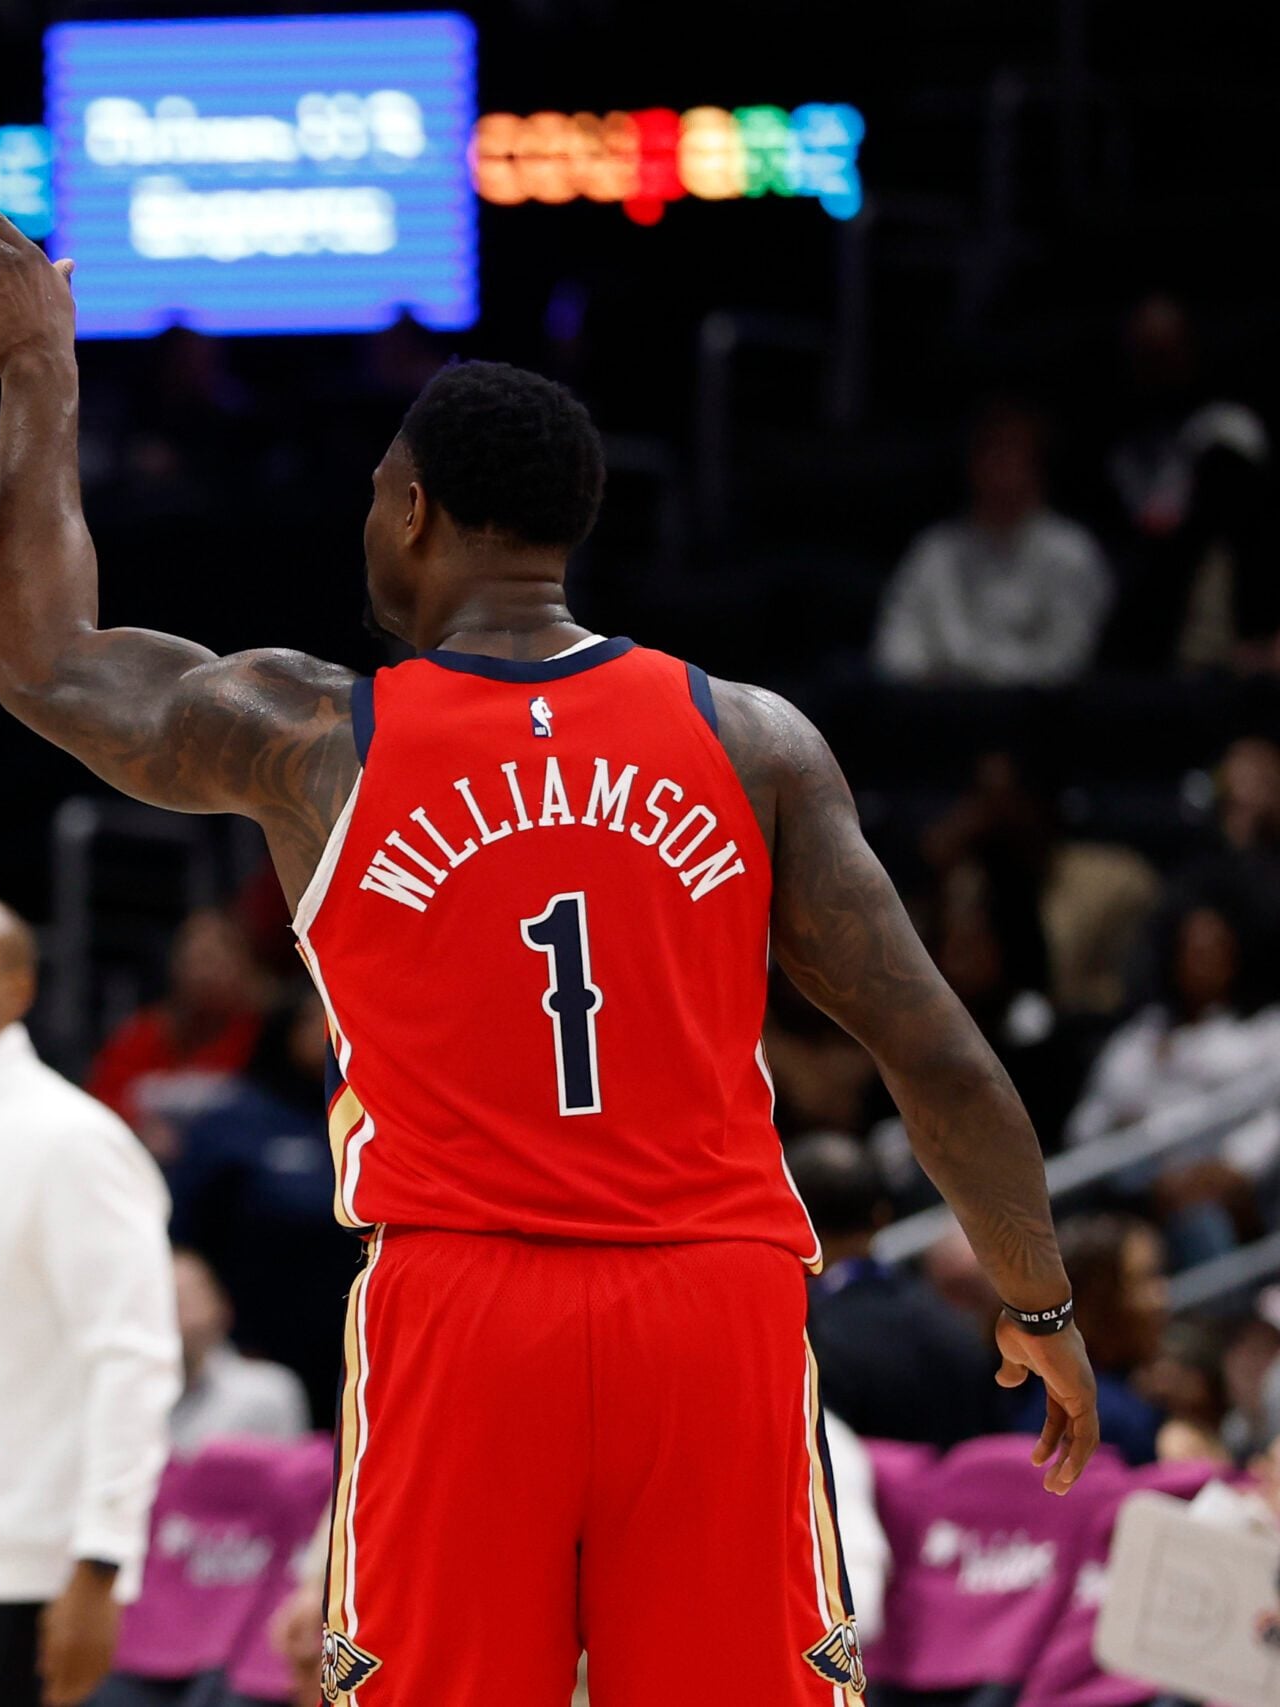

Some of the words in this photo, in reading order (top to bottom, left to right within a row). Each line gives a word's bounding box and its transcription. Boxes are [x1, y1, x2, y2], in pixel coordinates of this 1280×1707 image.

[359, 756, 746, 912] WILLIAMSON
[520, 891, 603, 1116] 1
[1021, 1313, 1039, 1322] DIE
[1042, 1310, 1058, 1320] TO
